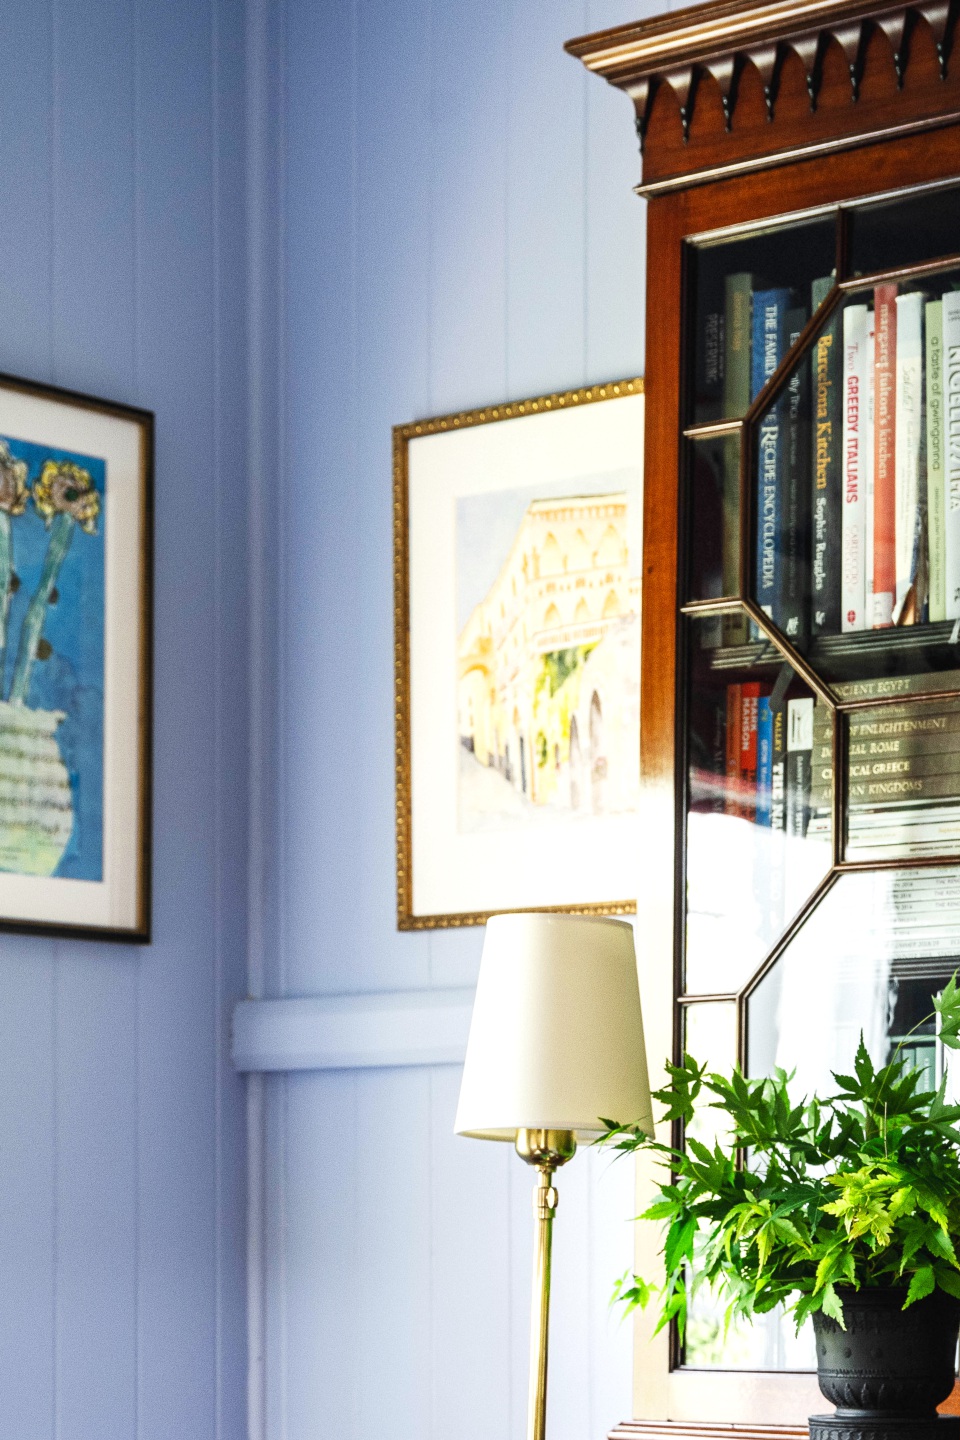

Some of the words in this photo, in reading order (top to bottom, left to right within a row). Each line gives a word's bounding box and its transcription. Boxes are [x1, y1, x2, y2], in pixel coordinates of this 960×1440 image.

[764, 304, 778, 331] THE
[878, 304, 890, 368] margaret
[764, 334, 778, 376] FAMILY
[817, 334, 832, 419] Barcelona
[847, 376, 859, 432] GREEDY
[878, 372, 890, 425] fulton's
[817, 421, 832, 489] Kitchen
[847, 438, 859, 503] ITALIANS
[878, 428, 890, 479] kitchen
[762, 486, 775, 588] ENCYCLOPEDIA
[813, 497, 826, 540] Sophie
[813, 542, 826, 590] Ruggles
[869, 741, 900, 754] ROME
[872, 761, 910, 775] GREECE
